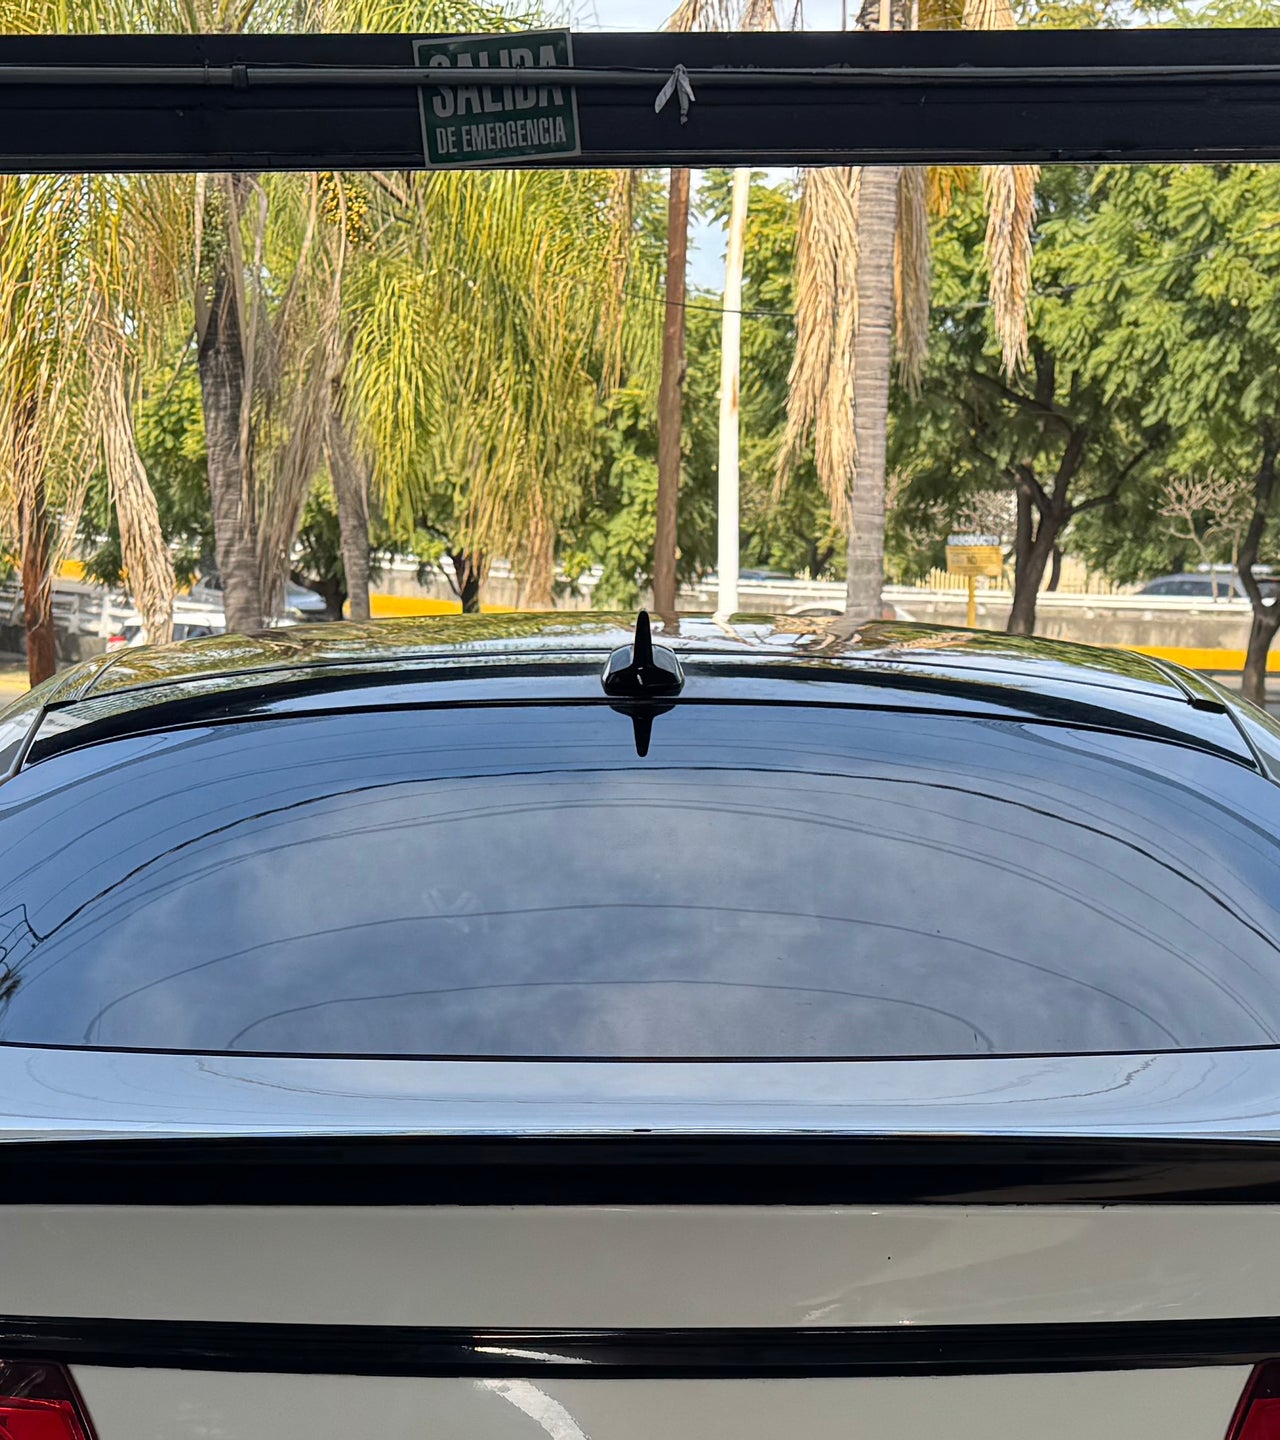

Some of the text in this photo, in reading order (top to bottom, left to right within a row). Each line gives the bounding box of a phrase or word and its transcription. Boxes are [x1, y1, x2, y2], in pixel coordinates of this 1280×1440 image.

[428, 45, 565, 118] SALIDA
[436, 116, 567, 154] DE EMERGENCIA
